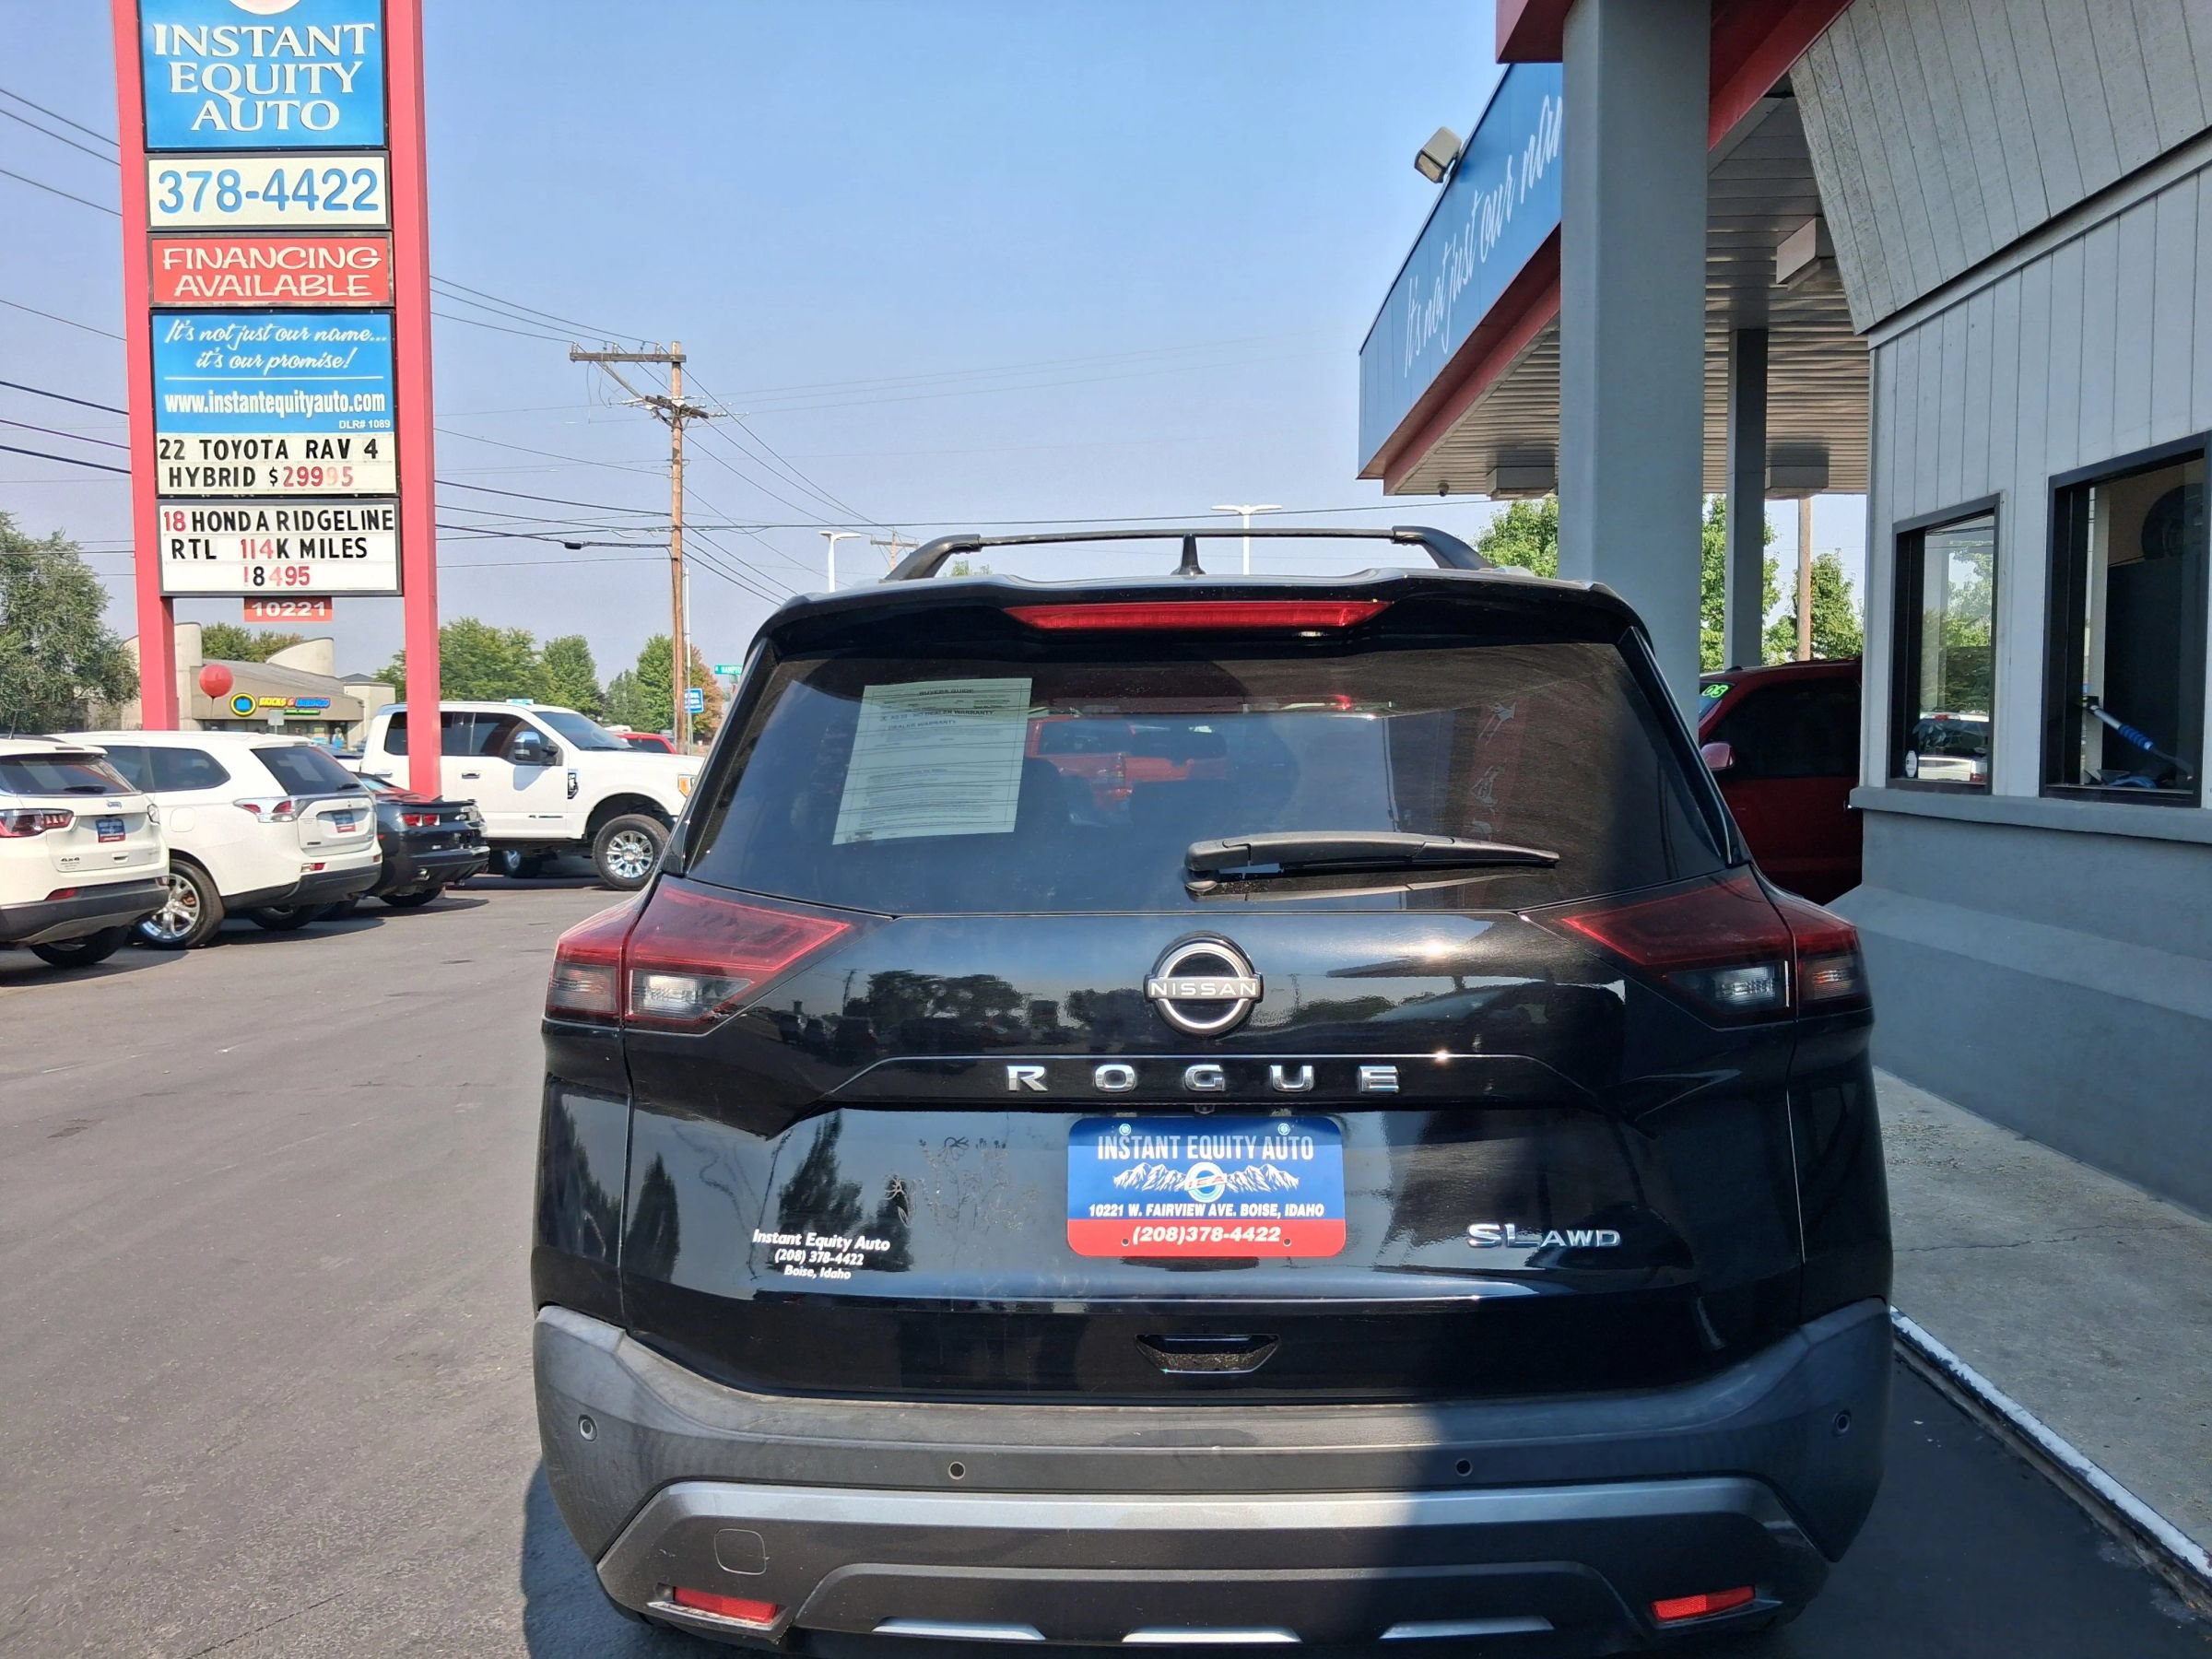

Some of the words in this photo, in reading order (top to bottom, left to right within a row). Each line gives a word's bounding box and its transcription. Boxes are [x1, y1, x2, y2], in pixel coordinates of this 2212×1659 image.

[153, 23, 375, 57] INSTANT
[170, 61, 363, 101] EQUITY
[191, 100, 339, 131] AUTO
[159, 168, 379, 213] 378-4422
[162, 246, 382, 270] FINANCING
[1405, 275, 1421, 379] It's
[1424, 241, 1453, 347] not
[1441, 189, 1484, 355] just
[1480, 155, 1514, 264] our
[174, 275, 372, 297] AVAILABLE
[164, 319, 195, 344] It's
[199, 324, 238, 342] not
[227, 324, 279, 351] just
[276, 328, 312, 342] our
[313, 328, 388, 342] name...
[195, 347, 224, 369] it's
[229, 353, 265, 369] our
[263, 347, 359, 376] promise!
[164, 389, 385, 418] www.instantequityauto.com
[338, 420, 366, 429] DLR#
[368, 419, 392, 429] 1089
[159, 440, 186, 460] 22
[199, 439, 289, 460] TOYOTA
[305, 438, 351, 459] RAV
[363, 438, 379, 459] 4
[169, 466, 256, 488] HYBRID
[164, 510, 186, 532] 18
[191, 510, 270, 532] HONDA
[276, 509, 395, 532] RIDGELINE
[171, 538, 218, 559] RTL
[300, 537, 369, 559] MILES
[251, 601, 325, 617] 10221
[1149, 981, 1259, 997] NISSAN
[1006, 1064, 1401, 1093] ROGUE
[1098, 1135, 1181, 1160] INSTANT
[1187, 1135, 1257, 1161] EQUITY
[1262, 1135, 1314, 1161] AUTO
[1088, 1204, 1124, 1218] 10221
[1127, 1204, 1143, 1218] W.
[1146, 1204, 1207, 1218] FAIRVIEW
[1207, 1204, 1237, 1218] AVE.
[1240, 1204, 1281, 1219] BOISE,
[1285, 1203, 1325, 1218] IDAHO
[752, 1229, 802, 1245] Instant
[805, 1231, 853, 1252] Equity
[853, 1235, 891, 1251] Auto
[1132, 1226, 1281, 1245] (208)378-4422
[1466, 1223, 1543, 1248] SL
[1540, 1229, 1621, 1248] AWD
[774, 1248, 806, 1265] (208)
[808, 1250, 865, 1265] 378-4422
[783, 1264, 818, 1279] Boise,
[819, 1266, 852, 1279] Idaho
